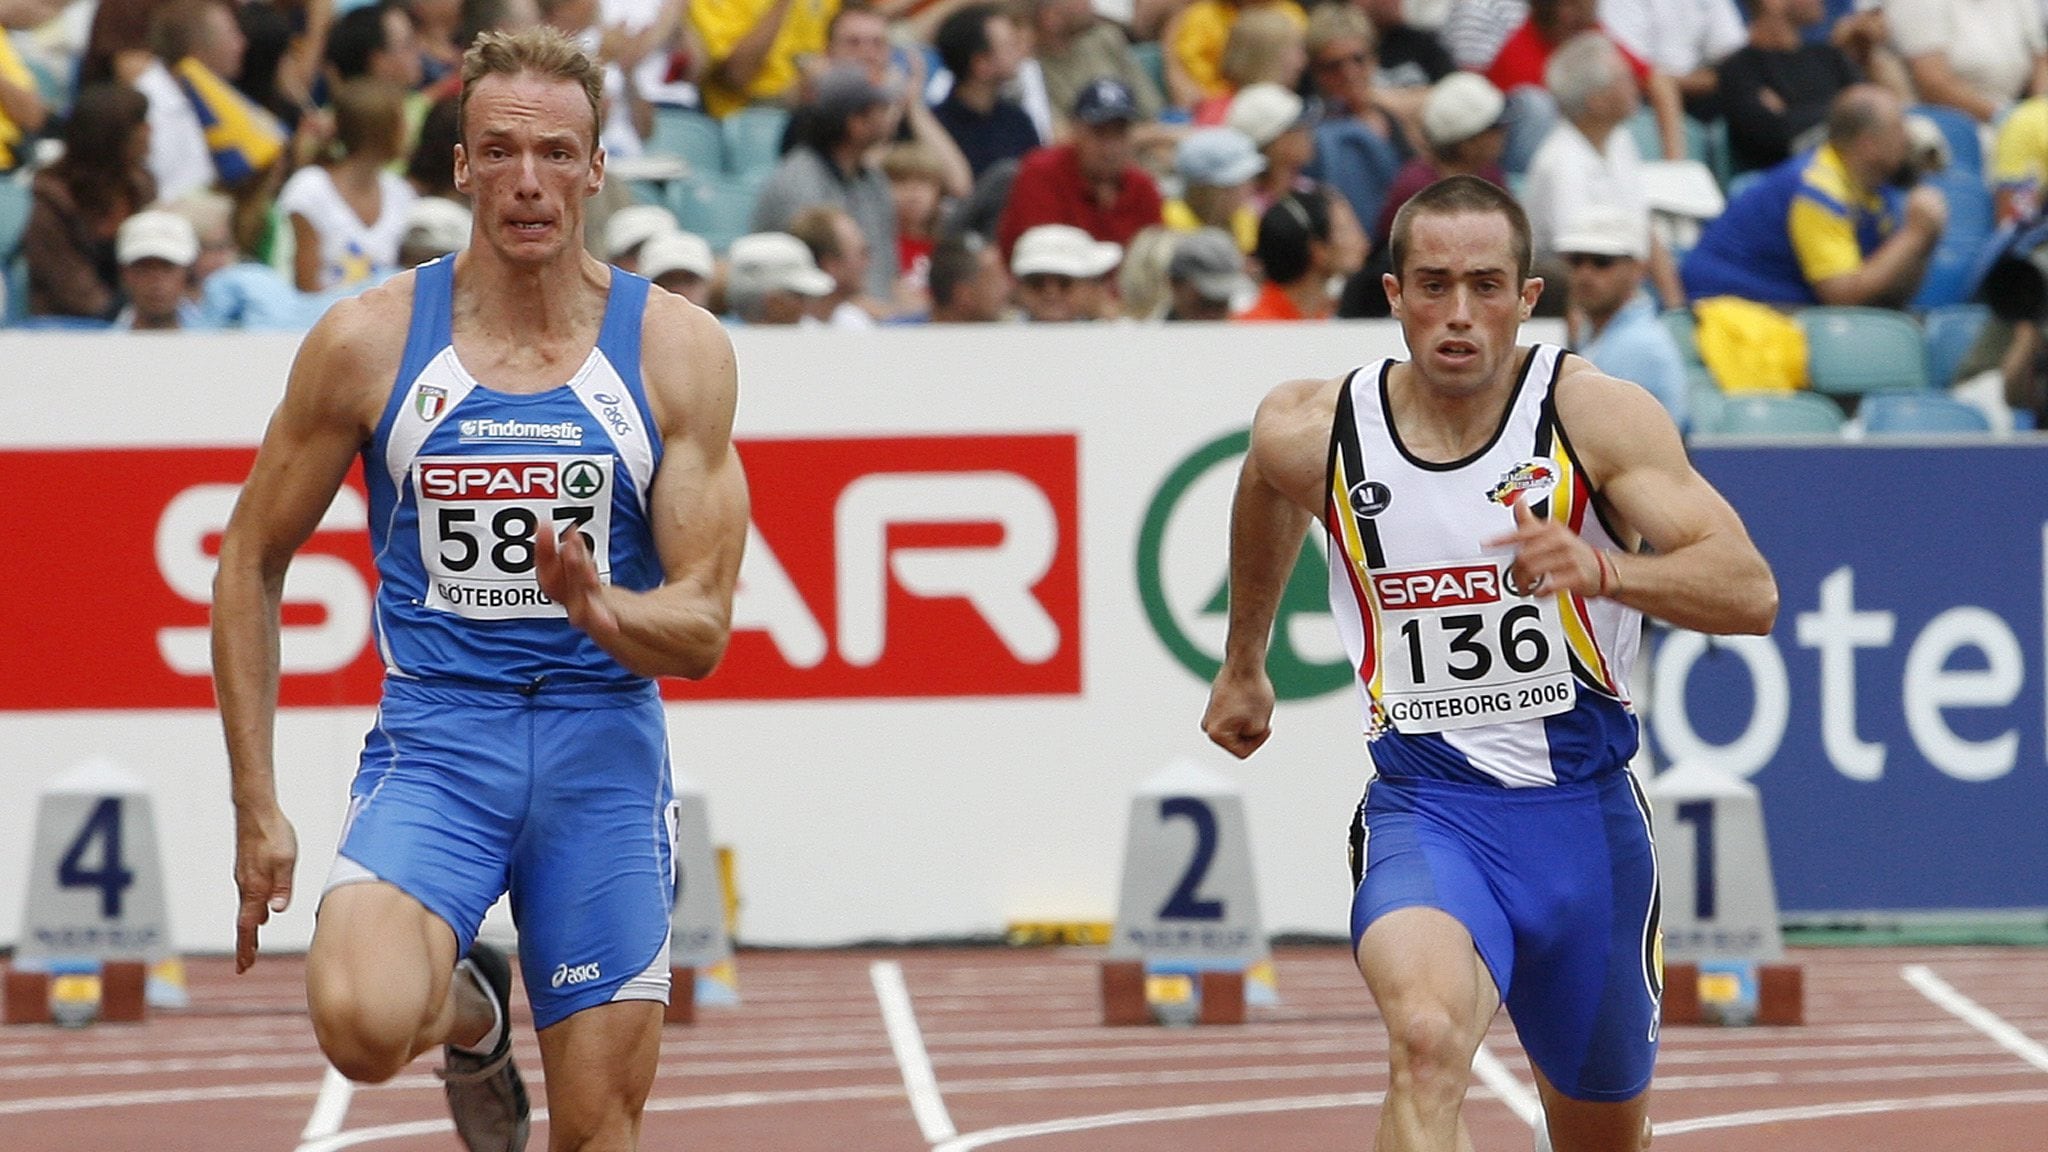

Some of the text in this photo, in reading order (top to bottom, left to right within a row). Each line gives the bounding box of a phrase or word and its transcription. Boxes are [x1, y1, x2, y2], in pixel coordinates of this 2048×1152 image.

[478, 419, 583, 439] Findomestic
[424, 467, 556, 496] SPAR
[153, 471, 1062, 676] SR
[438, 506, 595, 574] 583
[1379, 571, 1497, 605] SPAR
[1401, 604, 1550, 684] 136
[1391, 682, 1569, 721] GÖTEBORG 2006
[57, 796, 135, 918] 4
[1156, 796, 1226, 921] 2
[1675, 800, 1717, 921] 1
[565, 962, 601, 985] asics
